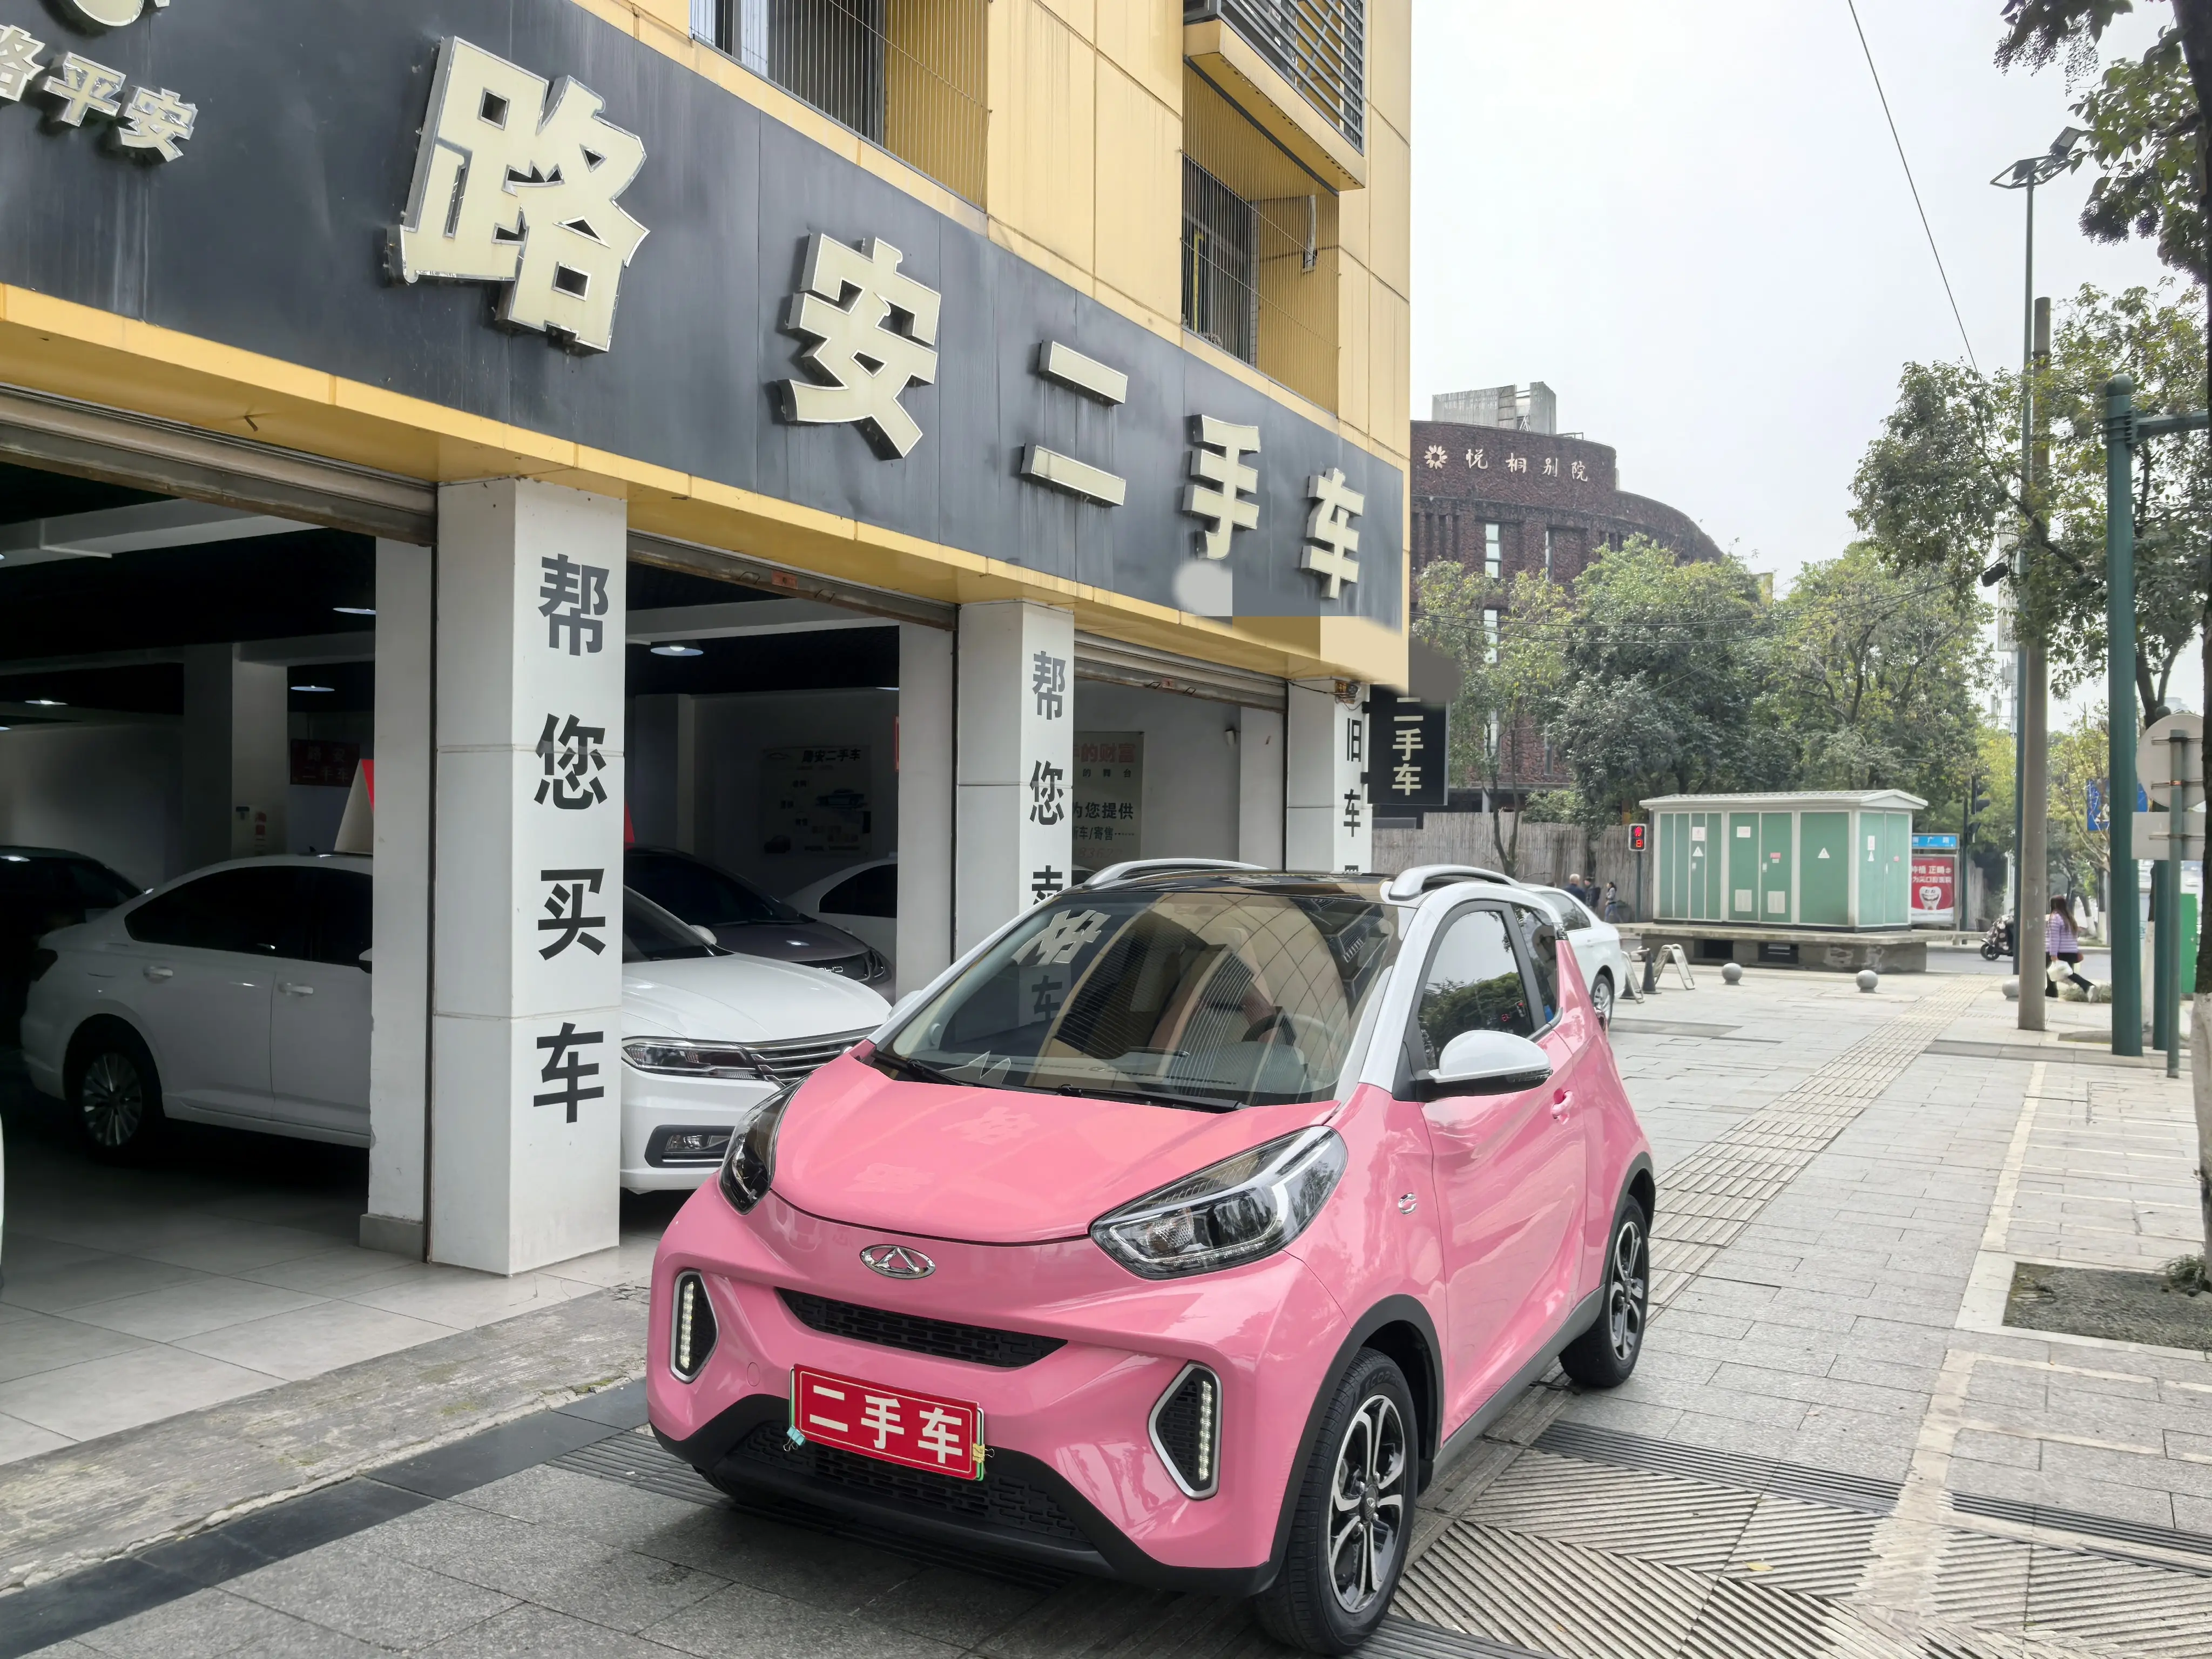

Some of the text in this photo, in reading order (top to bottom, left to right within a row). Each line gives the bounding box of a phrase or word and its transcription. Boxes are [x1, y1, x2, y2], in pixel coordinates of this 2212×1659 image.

[397, 36, 1365, 599] 路安二手车
[1465, 448, 1588, 482] 悦桐别院
[1344, 718, 1361, 872] 旧车
[1392, 697, 1424, 795] 二手车
[533, 553, 610, 1124] 帮您买车
[810, 1385, 963, 1464] 二手车
